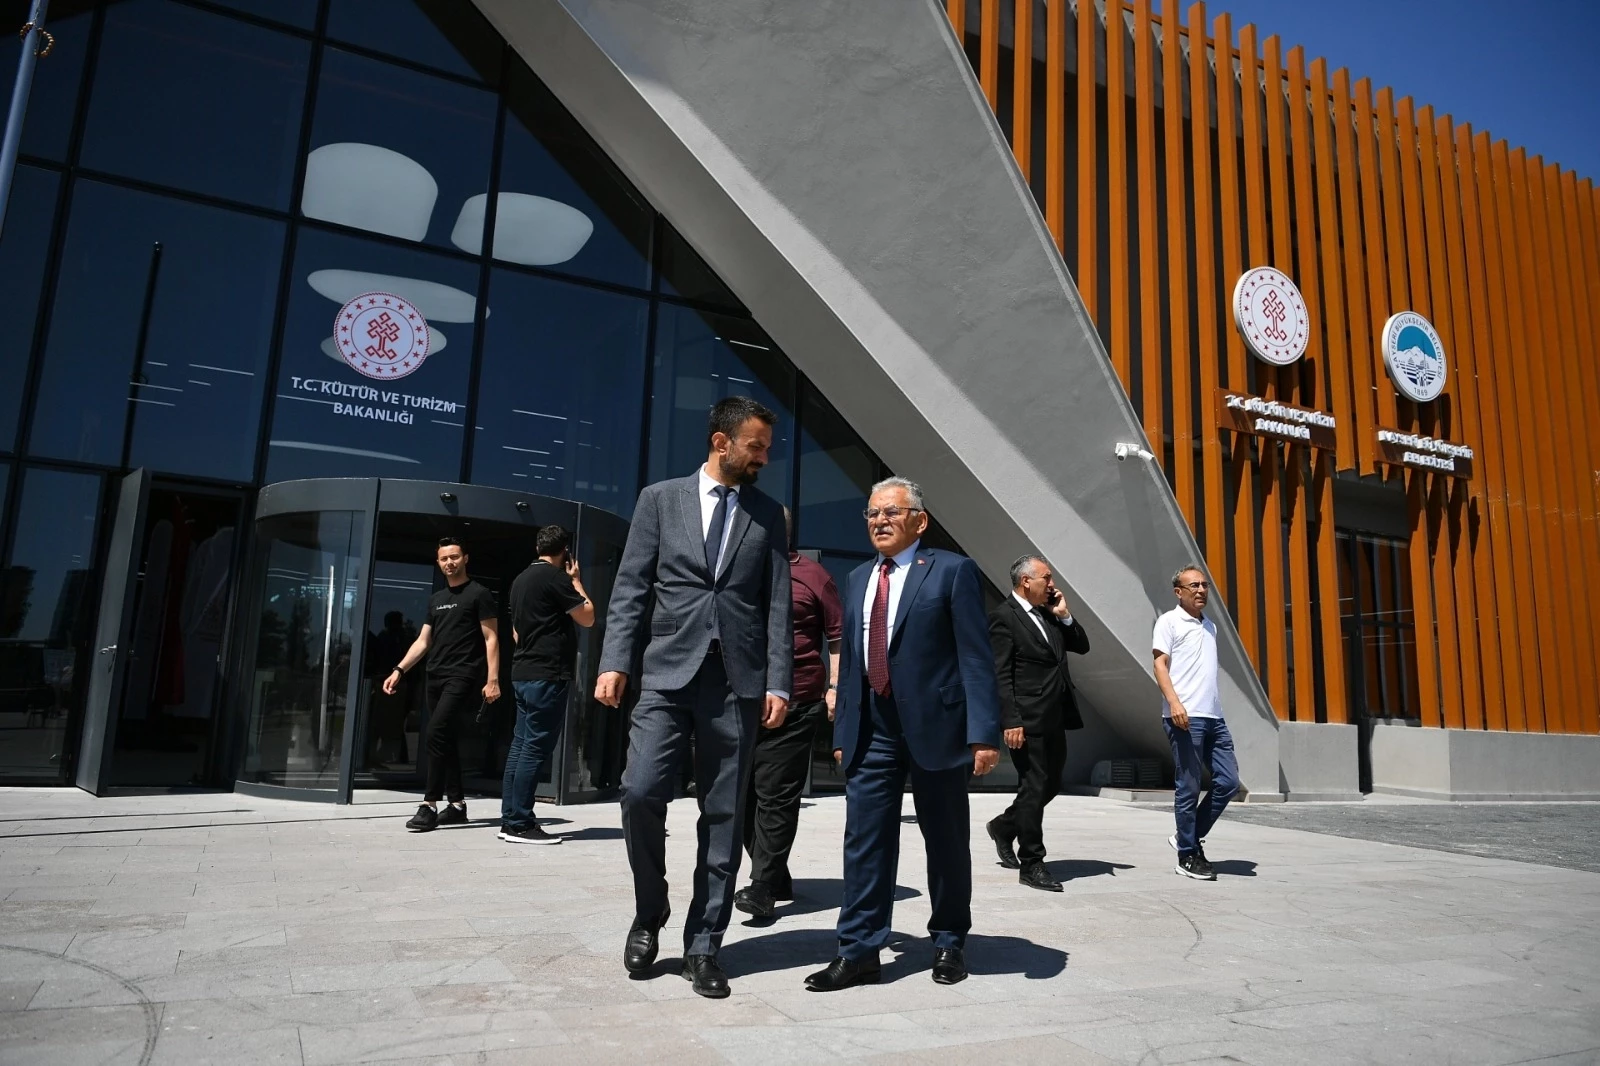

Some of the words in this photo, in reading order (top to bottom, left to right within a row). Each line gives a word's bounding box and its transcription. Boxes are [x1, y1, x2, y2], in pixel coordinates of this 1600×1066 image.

[291, 376, 317, 392] T.C.
[321, 381, 379, 401] KÜLTÜR
[381, 391, 400, 405] VE
[402, 395, 456, 414] TURİZM
[333, 402, 414, 425] BAKANLIĞI
